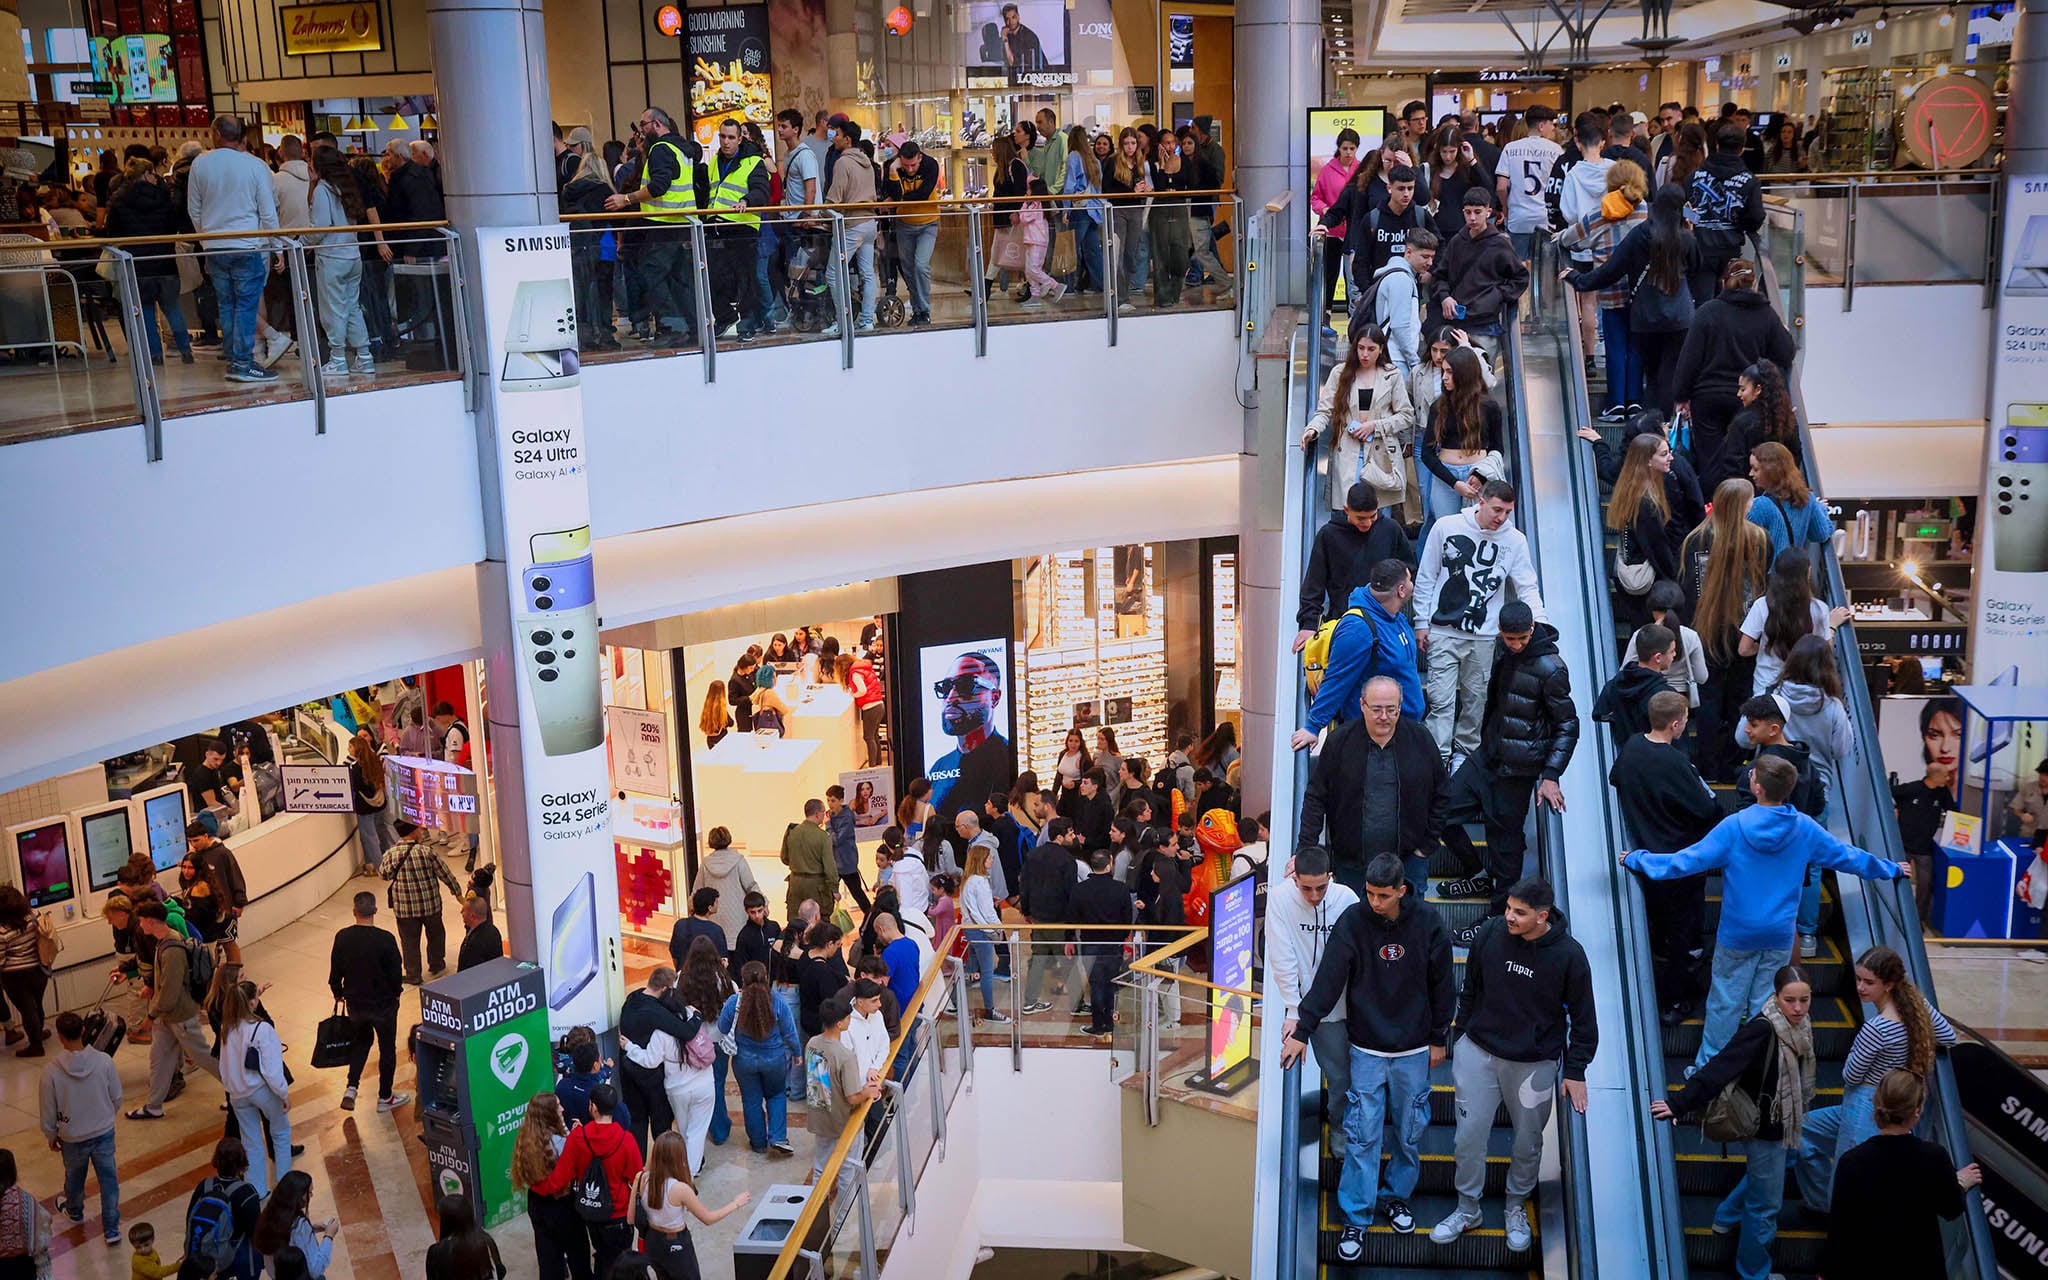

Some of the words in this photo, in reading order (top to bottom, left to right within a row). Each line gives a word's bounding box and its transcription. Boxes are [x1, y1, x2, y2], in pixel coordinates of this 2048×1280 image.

[688, 13, 708, 31] GOOD
[709, 10, 745, 29] MORNING
[690, 34, 726, 54] SUNSHINE
[1480, 72, 1518, 80] ZARA
[1523, 160, 1542, 196] 5
[512, 429, 571, 444] Galaxy
[514, 449, 543, 463] S24
[547, 447, 578, 461] Ultra
[515, 470, 557, 480] Galaxy
[559, 467, 568, 476] AI
[1986, 599, 2033, 613] Galaxy
[1985, 612, 2006, 623] S24
[641, 722, 660, 734] 20%
[641, 734, 661, 743] הנחה
[303, 777, 330, 785] מדרגות
[330, 777, 347, 785] חדר
[927, 768, 961, 781] VERSACE
[541, 788, 597, 807] Galaxy
[542, 811, 571, 825] S24
[543, 830, 583, 840] Galaxy
[1505, 960, 1535, 979] Tupac
[487, 981, 521, 1008] ATM
[431, 999, 452, 1015] ATM
[473, 993, 537, 1031] כספומט
[423, 1007, 462, 1030] כספומט
[440, 1144, 457, 1158] ATM
[429, 1150, 469, 1174] כספומט
